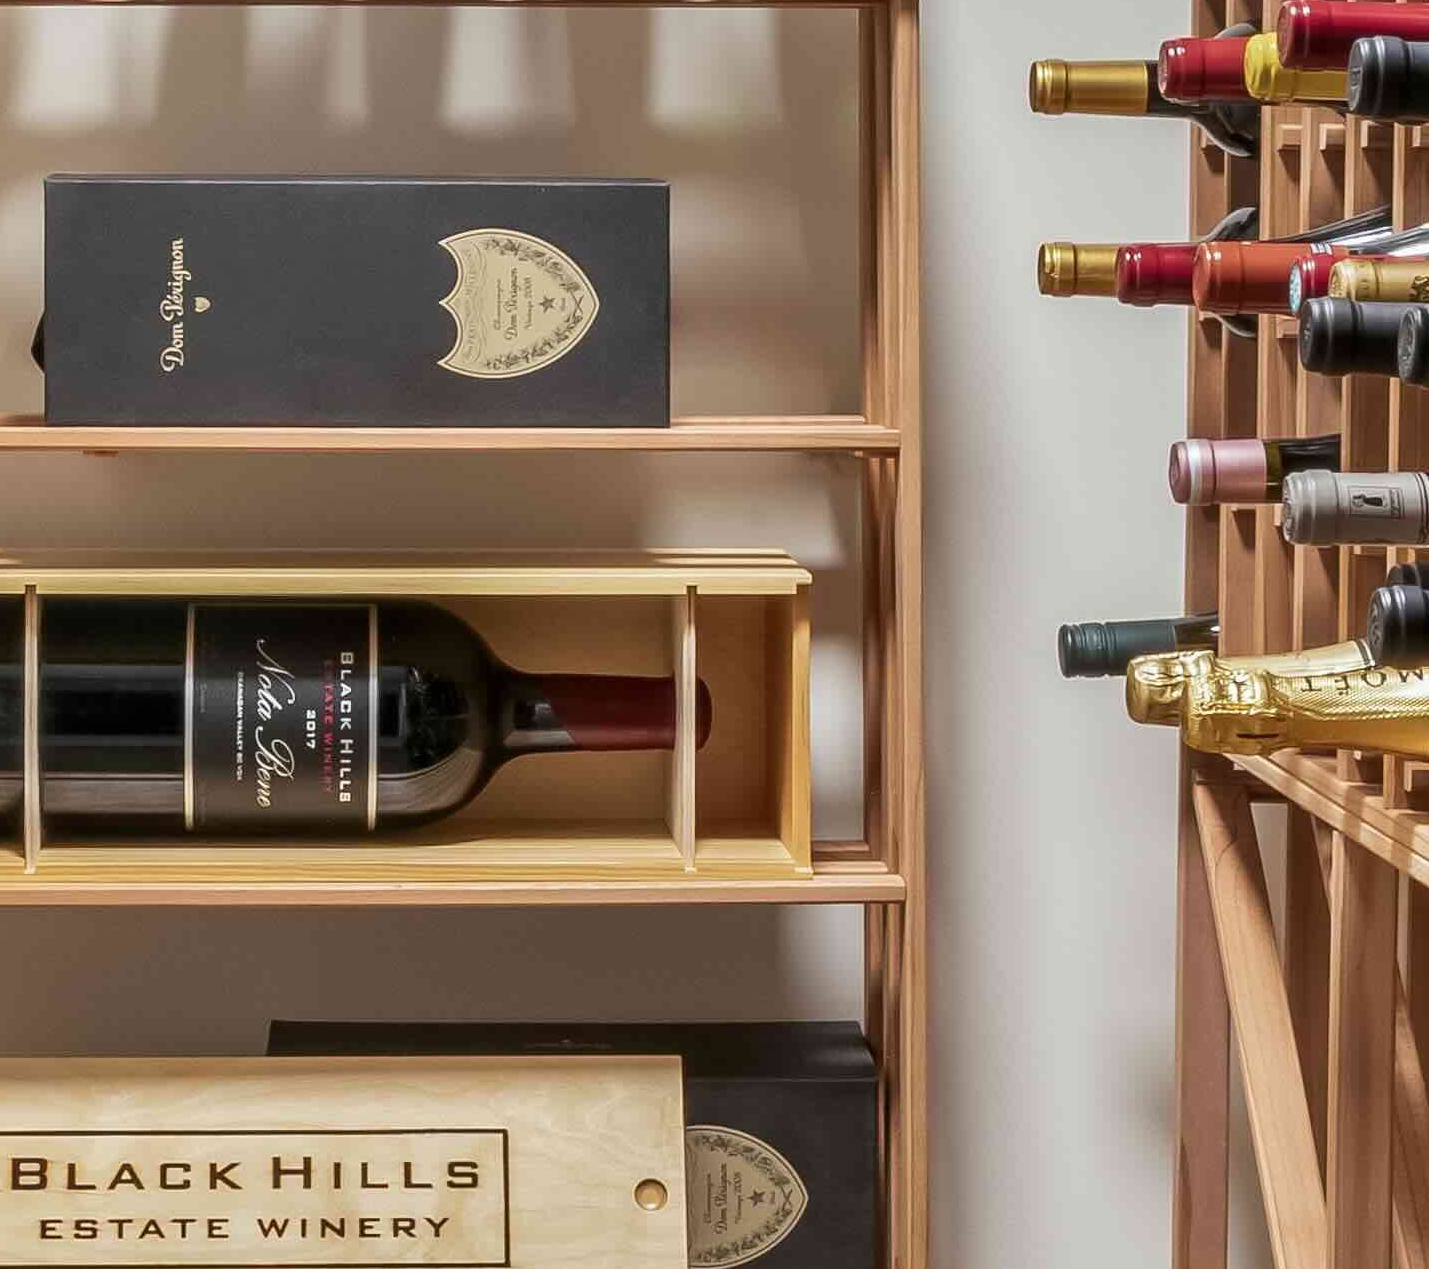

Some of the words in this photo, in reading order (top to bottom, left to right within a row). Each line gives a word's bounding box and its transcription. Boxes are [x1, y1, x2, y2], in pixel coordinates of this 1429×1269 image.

[159, 237, 193, 322] Pérignon
[159, 321, 185, 372] Dom
[256, 638, 296, 721] Nota
[340, 651, 354, 730] BLACK
[306, 710, 316, 749] 2017
[255, 726, 296, 809] Bene
[339, 739, 354, 802] HILLS
[11, 1156, 243, 1191] BLACK
[272, 1156, 480, 1190] HILLS
[40, 1218, 229, 1240] ESTATE
[257, 1217, 450, 1238] WINERY
